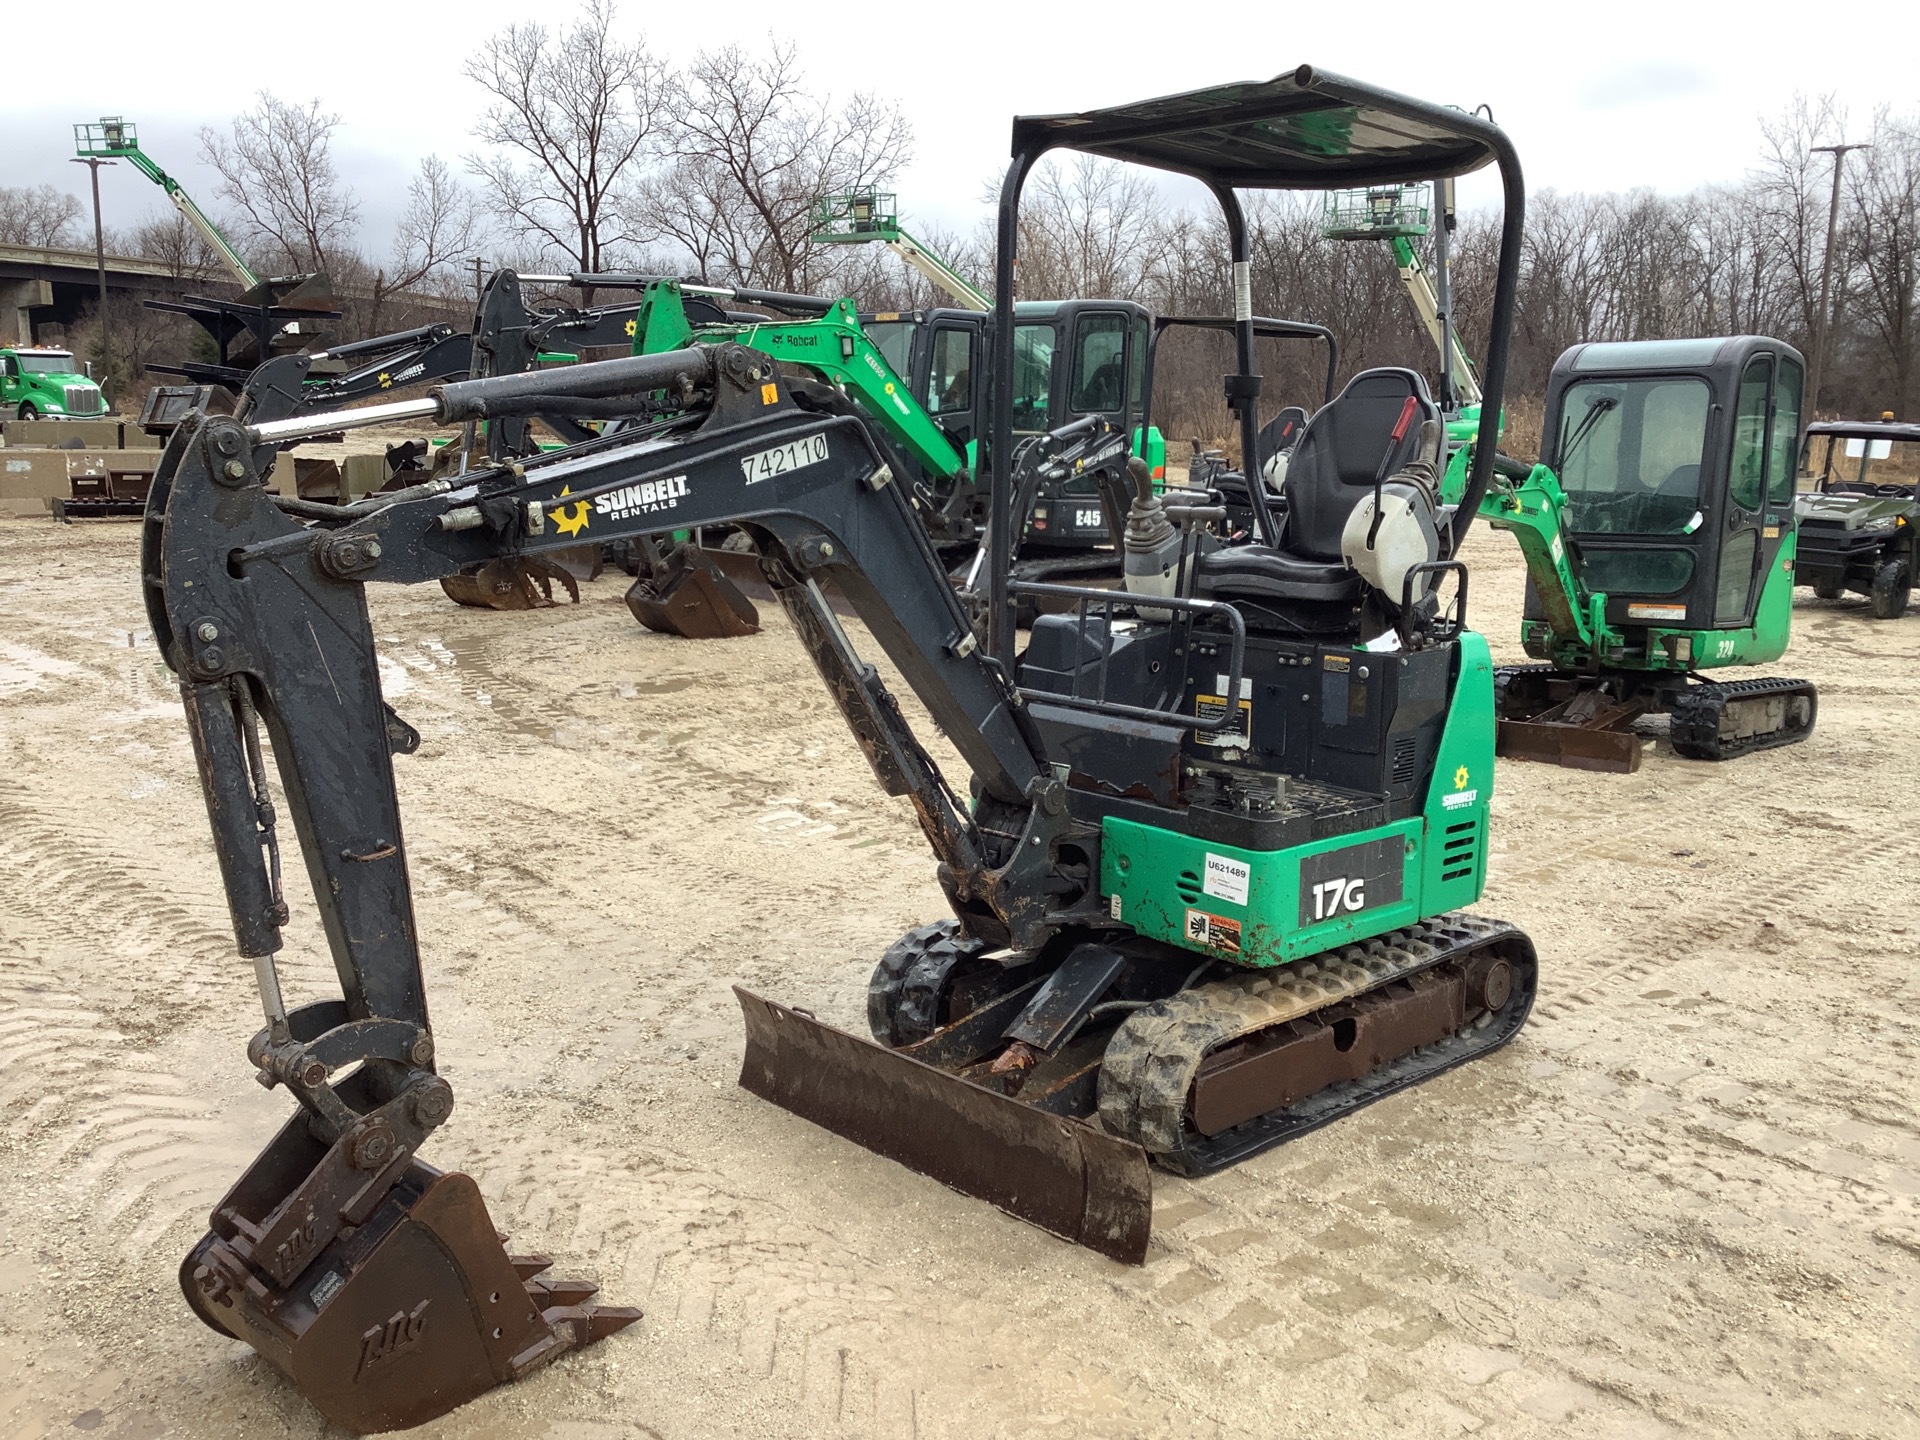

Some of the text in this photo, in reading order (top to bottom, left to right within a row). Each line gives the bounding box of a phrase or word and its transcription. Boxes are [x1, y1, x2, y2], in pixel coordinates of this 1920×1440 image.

[787, 335, 818, 347] Bobcat
[743, 434, 826, 483] 742110
[594, 475, 688, 514] SUNBELT
[610, 498, 678, 521] RENTALS
[1075, 509, 1102, 527] E45
[1716, 640, 1735, 659] 324
[1442, 789, 1478, 807] SUNBELT
[1446, 801, 1473, 811] RENTALS
[1208, 860, 1247, 879] U621489
[1312, 877, 1365, 920] 17G
